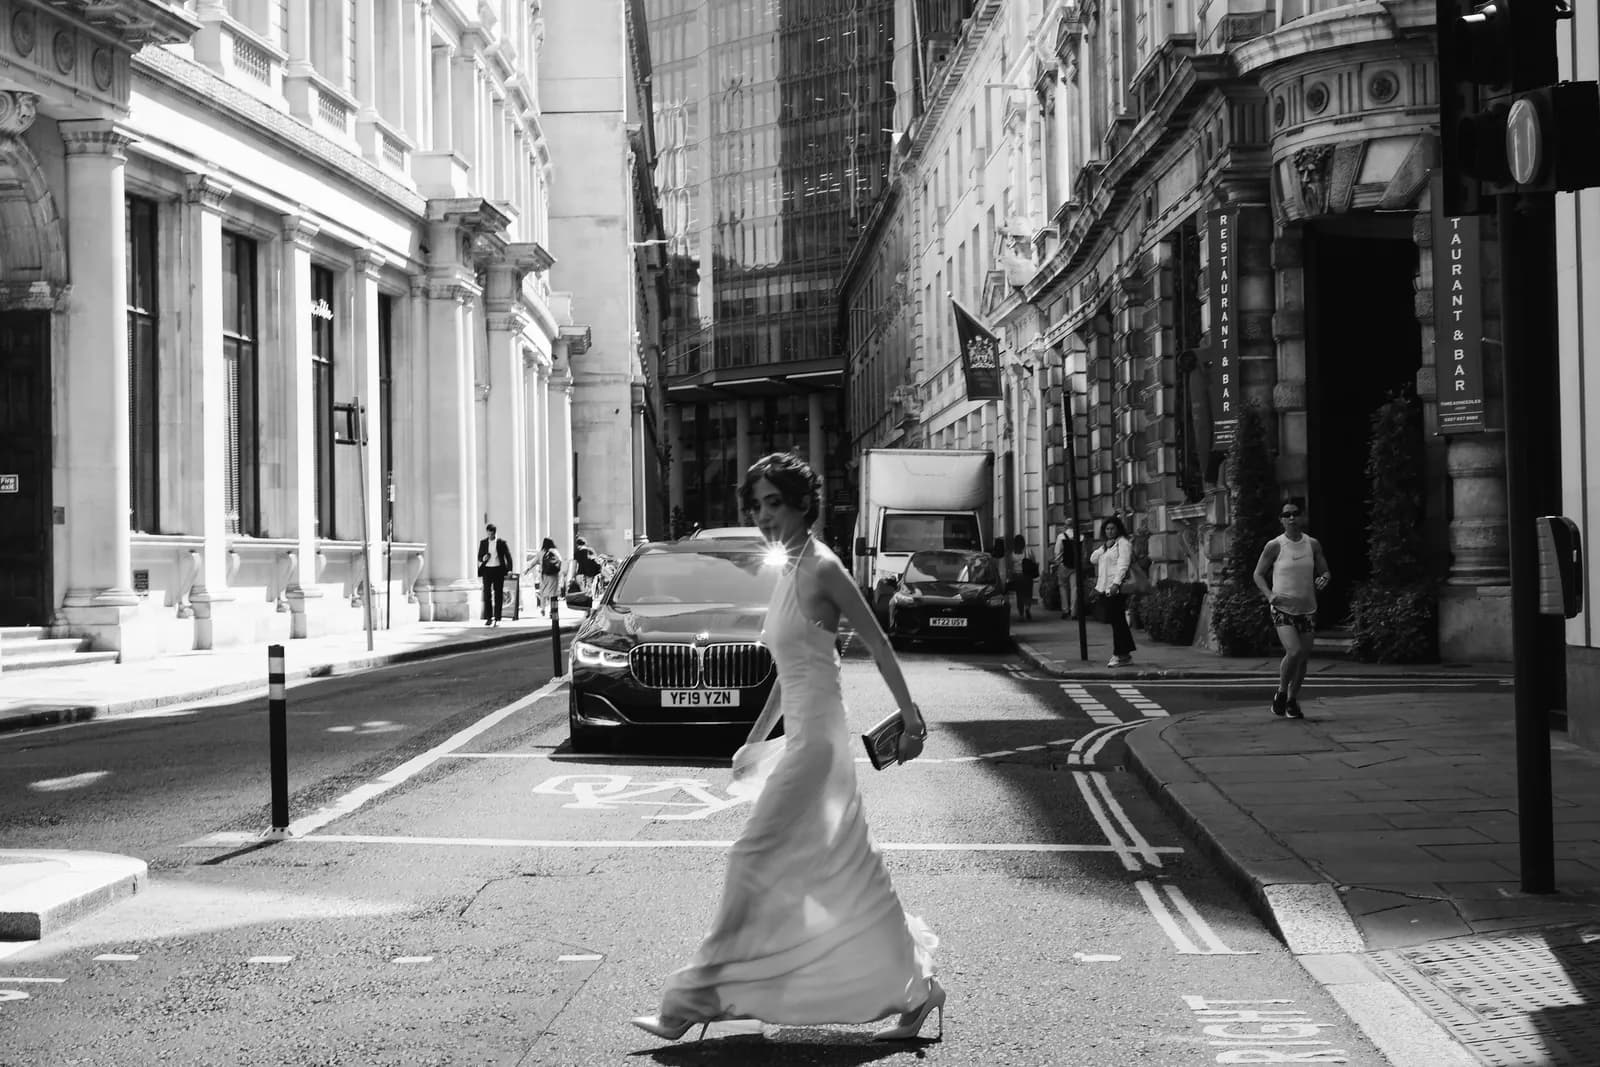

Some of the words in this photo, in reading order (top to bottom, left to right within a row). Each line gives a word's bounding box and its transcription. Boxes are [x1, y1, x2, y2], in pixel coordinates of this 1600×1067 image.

[1220, 215, 1229, 349] RESTAURANT
[1450, 217, 1463, 321] TAURANT
[1453, 329, 1464, 341] &
[1222, 356, 1229, 367] &
[1454, 349, 1465, 391] BAR
[670, 691, 701, 705] YF19
[704, 691, 731, 705] YZN
[1181, 995, 1348, 1064] RIGHT
